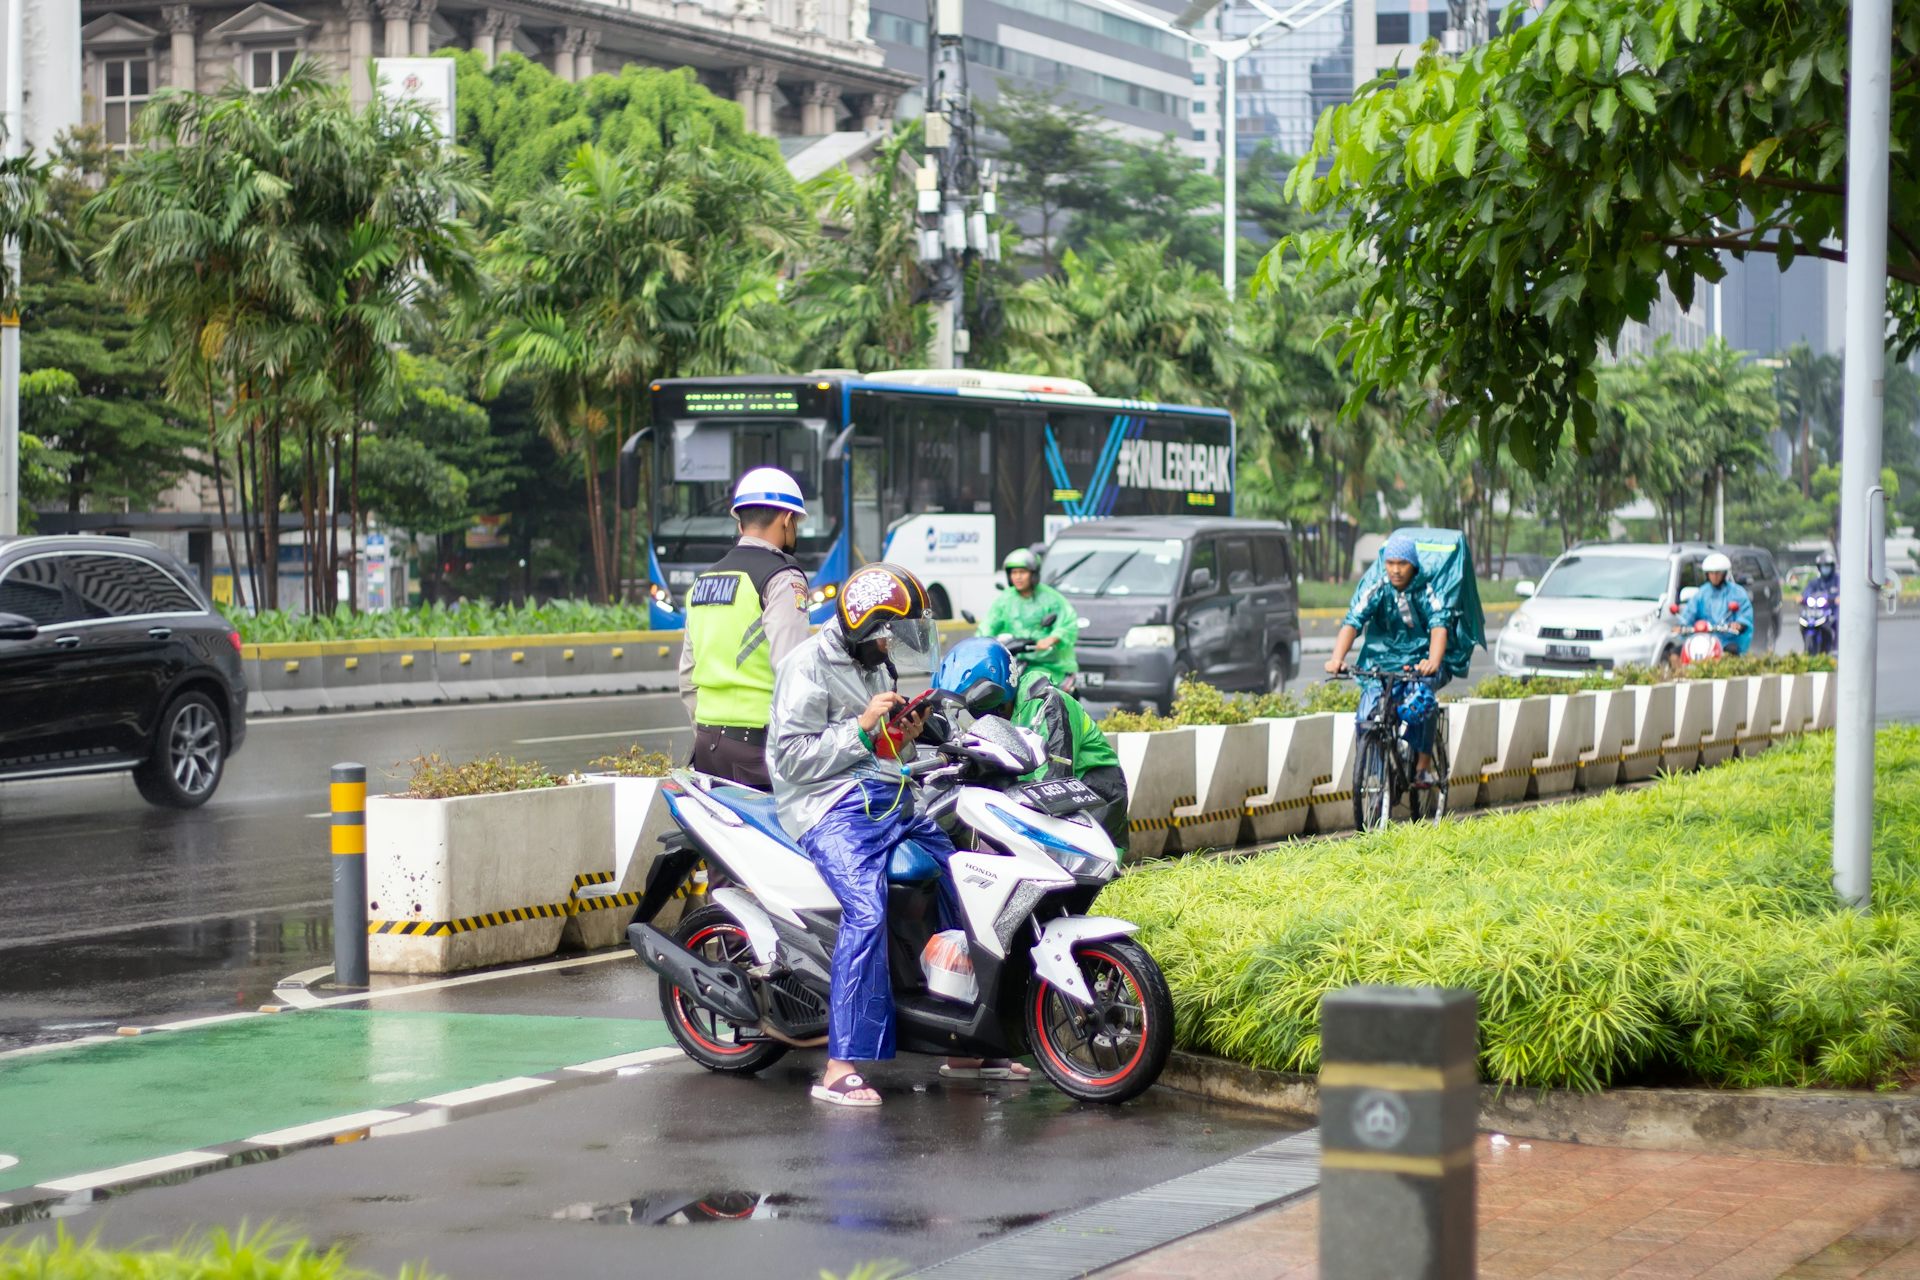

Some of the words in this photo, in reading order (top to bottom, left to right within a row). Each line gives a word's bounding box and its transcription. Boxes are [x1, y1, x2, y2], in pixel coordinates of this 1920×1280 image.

[692, 577, 738, 602] SATPAM
[1027, 789, 1041, 800] B
[965, 862, 998, 880] HONDA
